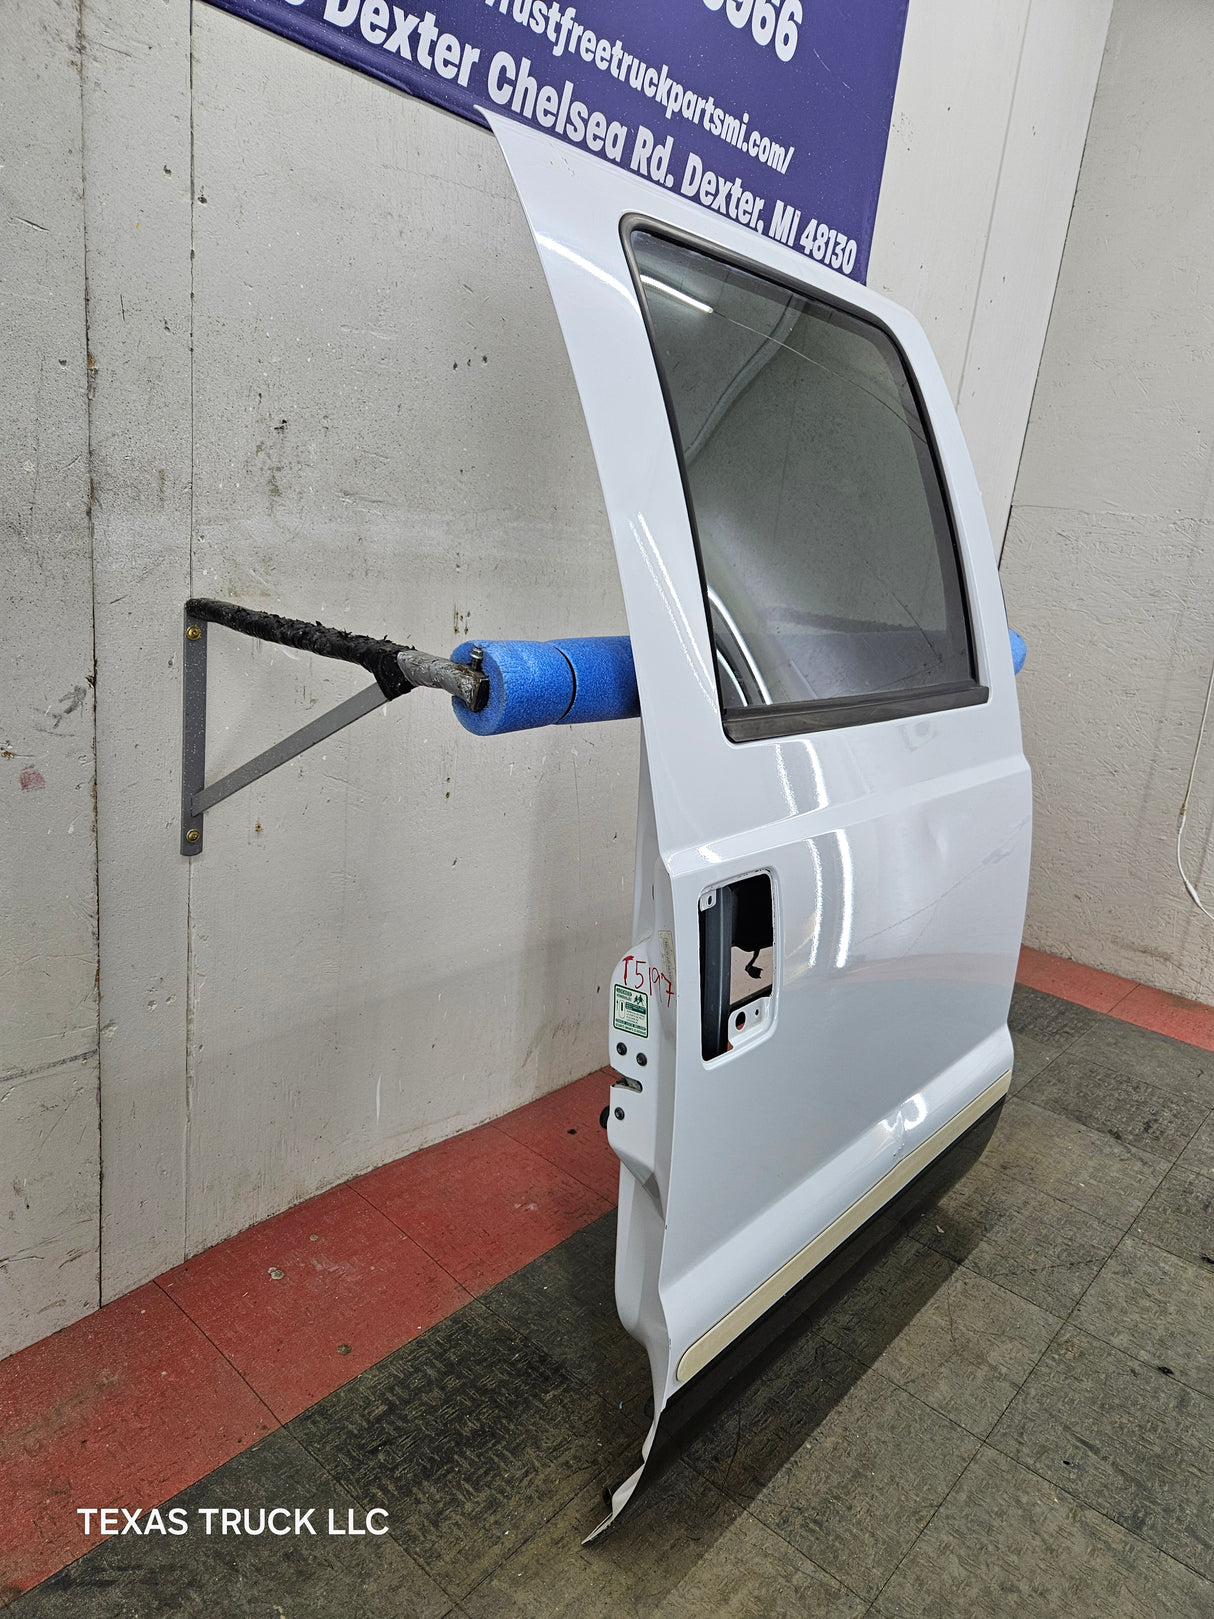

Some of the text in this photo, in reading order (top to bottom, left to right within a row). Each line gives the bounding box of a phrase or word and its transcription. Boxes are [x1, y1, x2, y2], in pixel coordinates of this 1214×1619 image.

[488, 51, 627, 162] Chelsea
[630, 125, 675, 188] Rd.
[681, 152, 764, 235] Dexter,
[769, 200, 802, 246] MI
[800, 219, 857, 275] 48130
